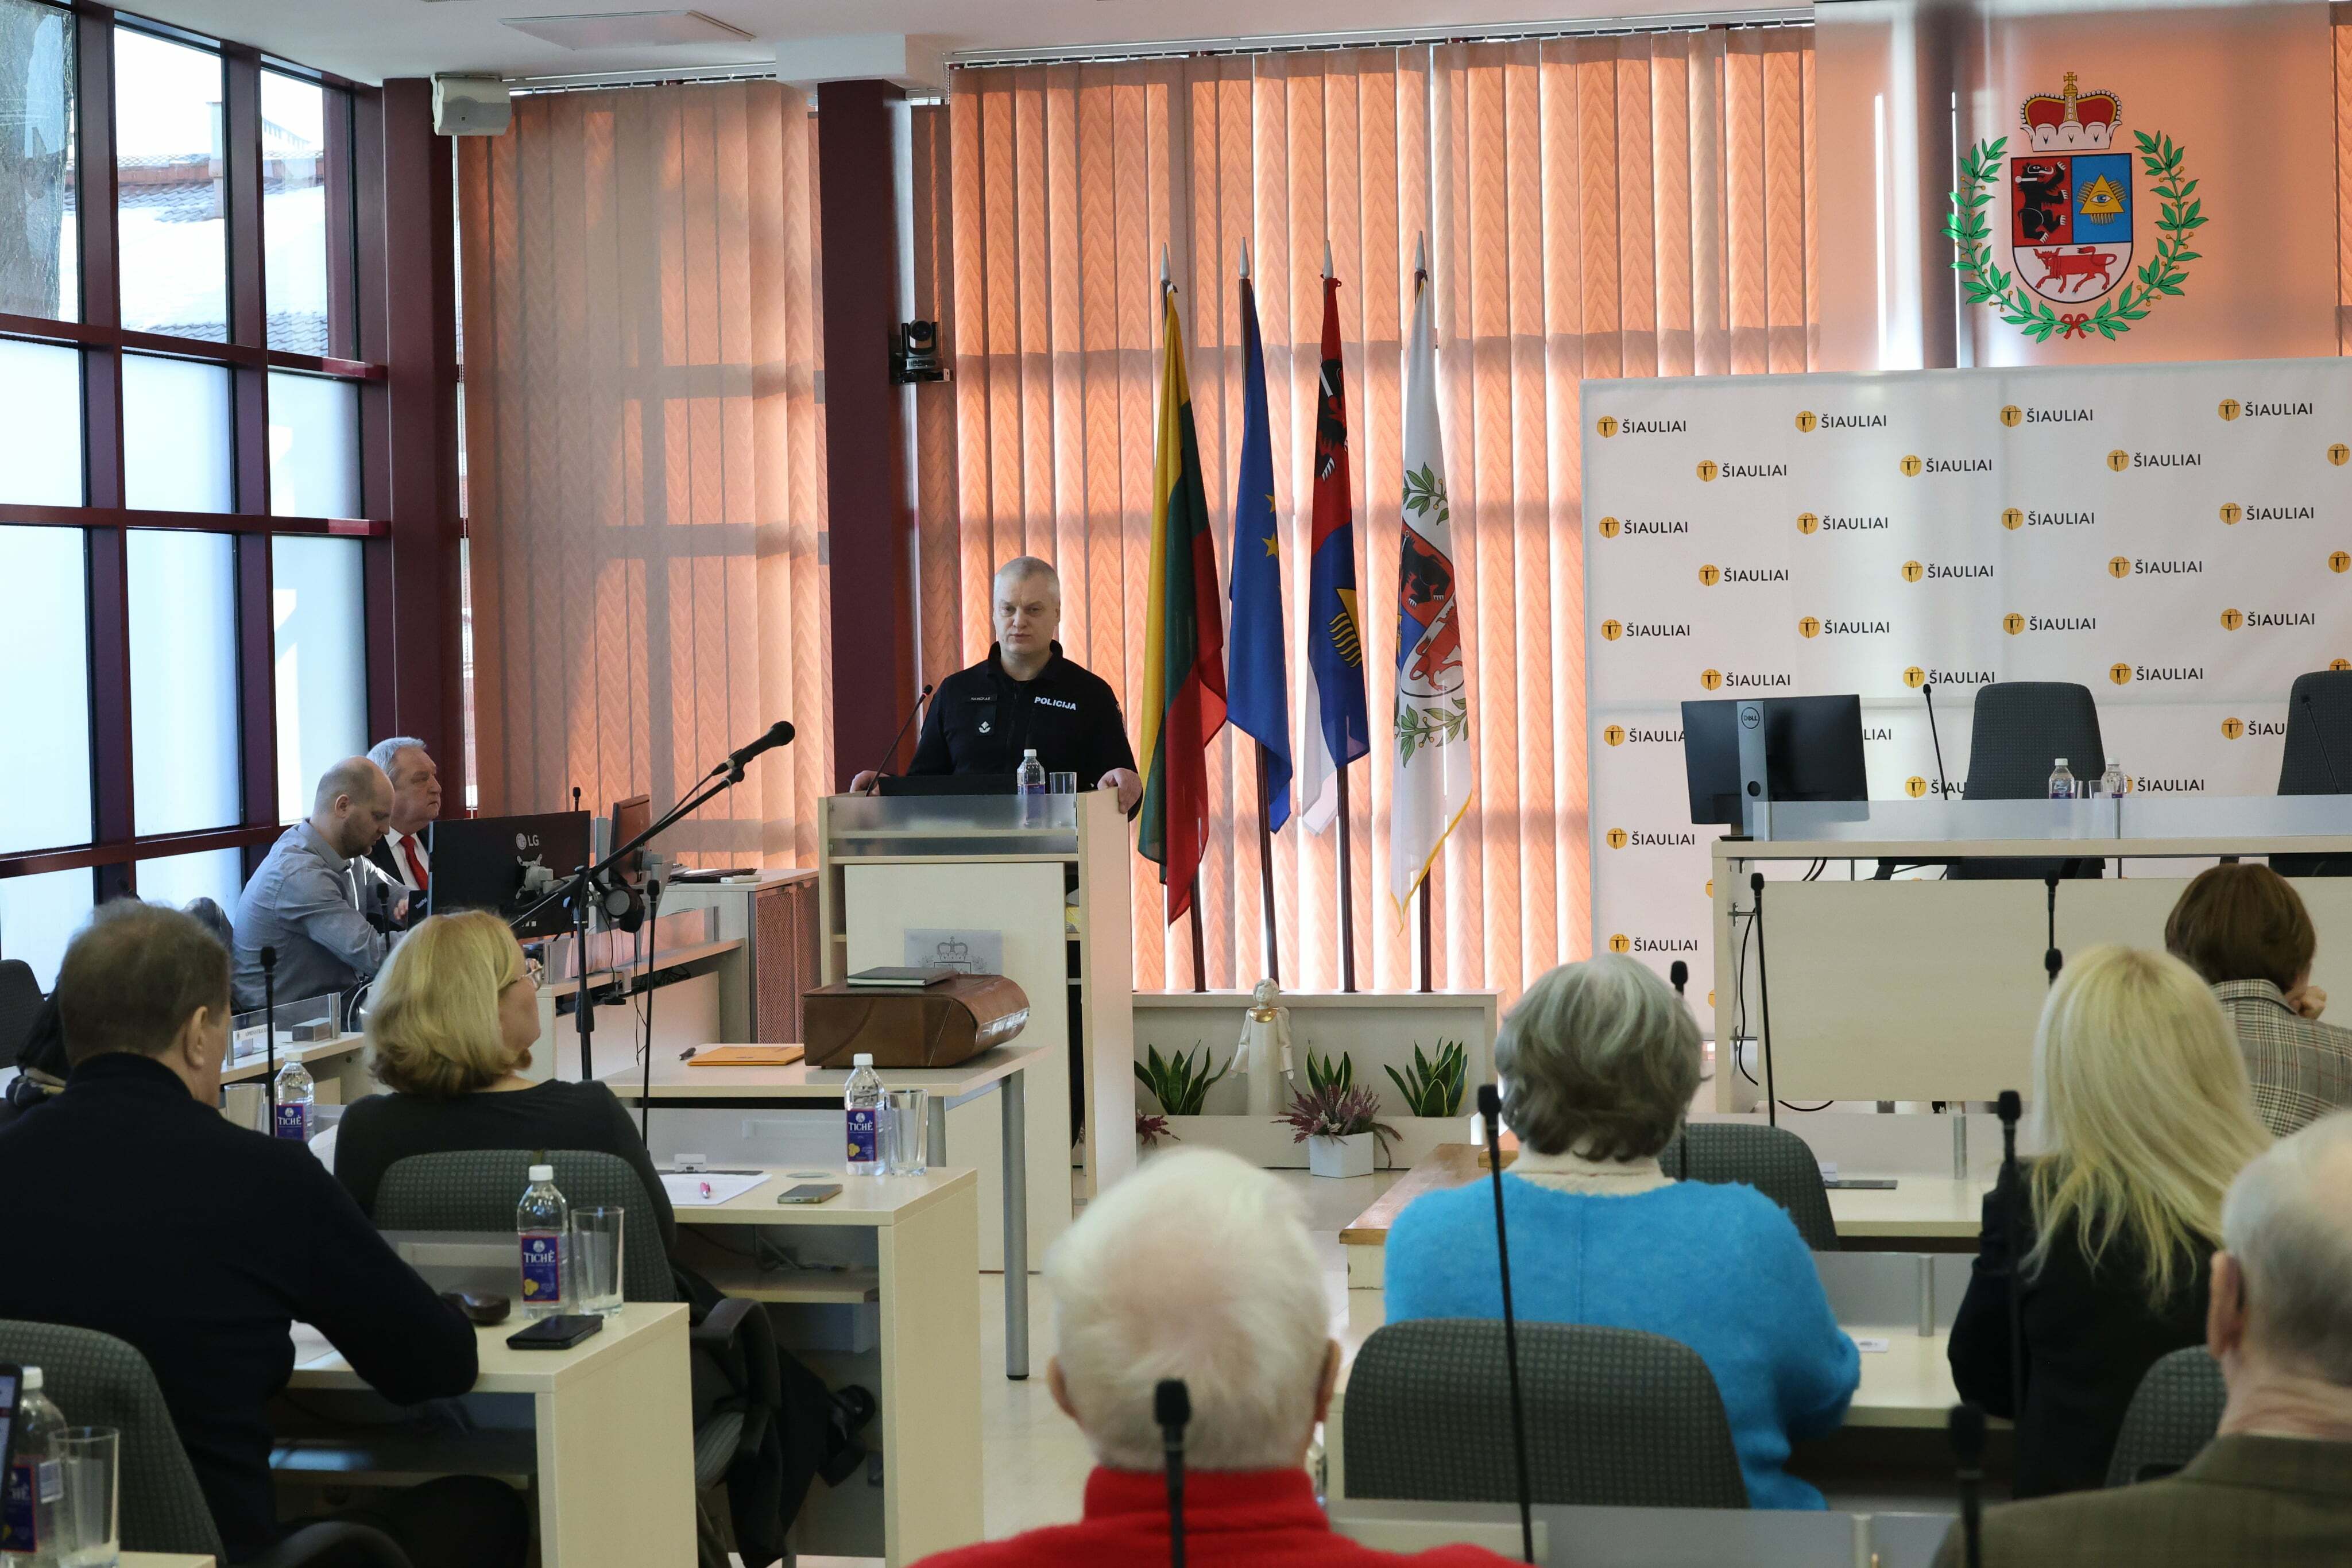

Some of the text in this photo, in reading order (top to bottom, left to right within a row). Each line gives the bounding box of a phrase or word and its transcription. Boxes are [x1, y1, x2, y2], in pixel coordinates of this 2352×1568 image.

[2027, 408, 2092, 423] ŠIAULIAI
[2245, 402, 2312, 416] ŠIAULIAI
[1623, 419, 1686, 433] ŠIAULIAI
[1821, 413, 1886, 428] ŠIAULIAI
[1927, 458, 1991, 472] ŠIAULIAI
[2134, 452, 2200, 467] ŠIAULIAI
[1723, 463, 1786, 477] ŠIAULIAI
[2028, 511, 2094, 525] ŠIAULIAI
[2247, 506, 2314, 520] ŠIAULIAI
[1624, 520, 1688, 534] ŠIAULIAI
[1823, 516, 1887, 530] ŠIAULIAI
[1928, 564, 1993, 578] ŠIAULIAI
[2136, 559, 2202, 574] ŠIAULIAI
[1724, 568, 1788, 582] ŠIAULIAI
[2030, 616, 2095, 630] ŠIAULIAI
[2248, 611, 2314, 626] ŠIAULIAI
[1627, 622, 1689, 636] ŠIAULIAI
[1825, 620, 1889, 634] ŠIAULIAI
[1726, 672, 1790, 686] ŠIAULIAI
[1929, 669, 1995, 684] ŠIAULIAI
[2137, 666, 2203, 680] ŠIAULIAI
[1034, 696, 1076, 710] POLICIJA
[1864, 729, 1891, 740] LIAI
[2249, 721, 2285, 735] ŠIAU
[1630, 729, 1685, 742] ŠIAULIA
[1931, 779, 1967, 793] ŠIAU
[2138, 777, 2204, 791] ŠIAULIAI
[527, 835, 539, 846] LG
[1632, 831, 1695, 845] ŠIAULIAI
[1634, 938, 1697, 951] ŠIAULIAI
[278, 1115, 301, 1125] TICHĖ
[848, 1120, 873, 1131] TICHĖ
[523, 1249, 555, 1263] TICHĖ
